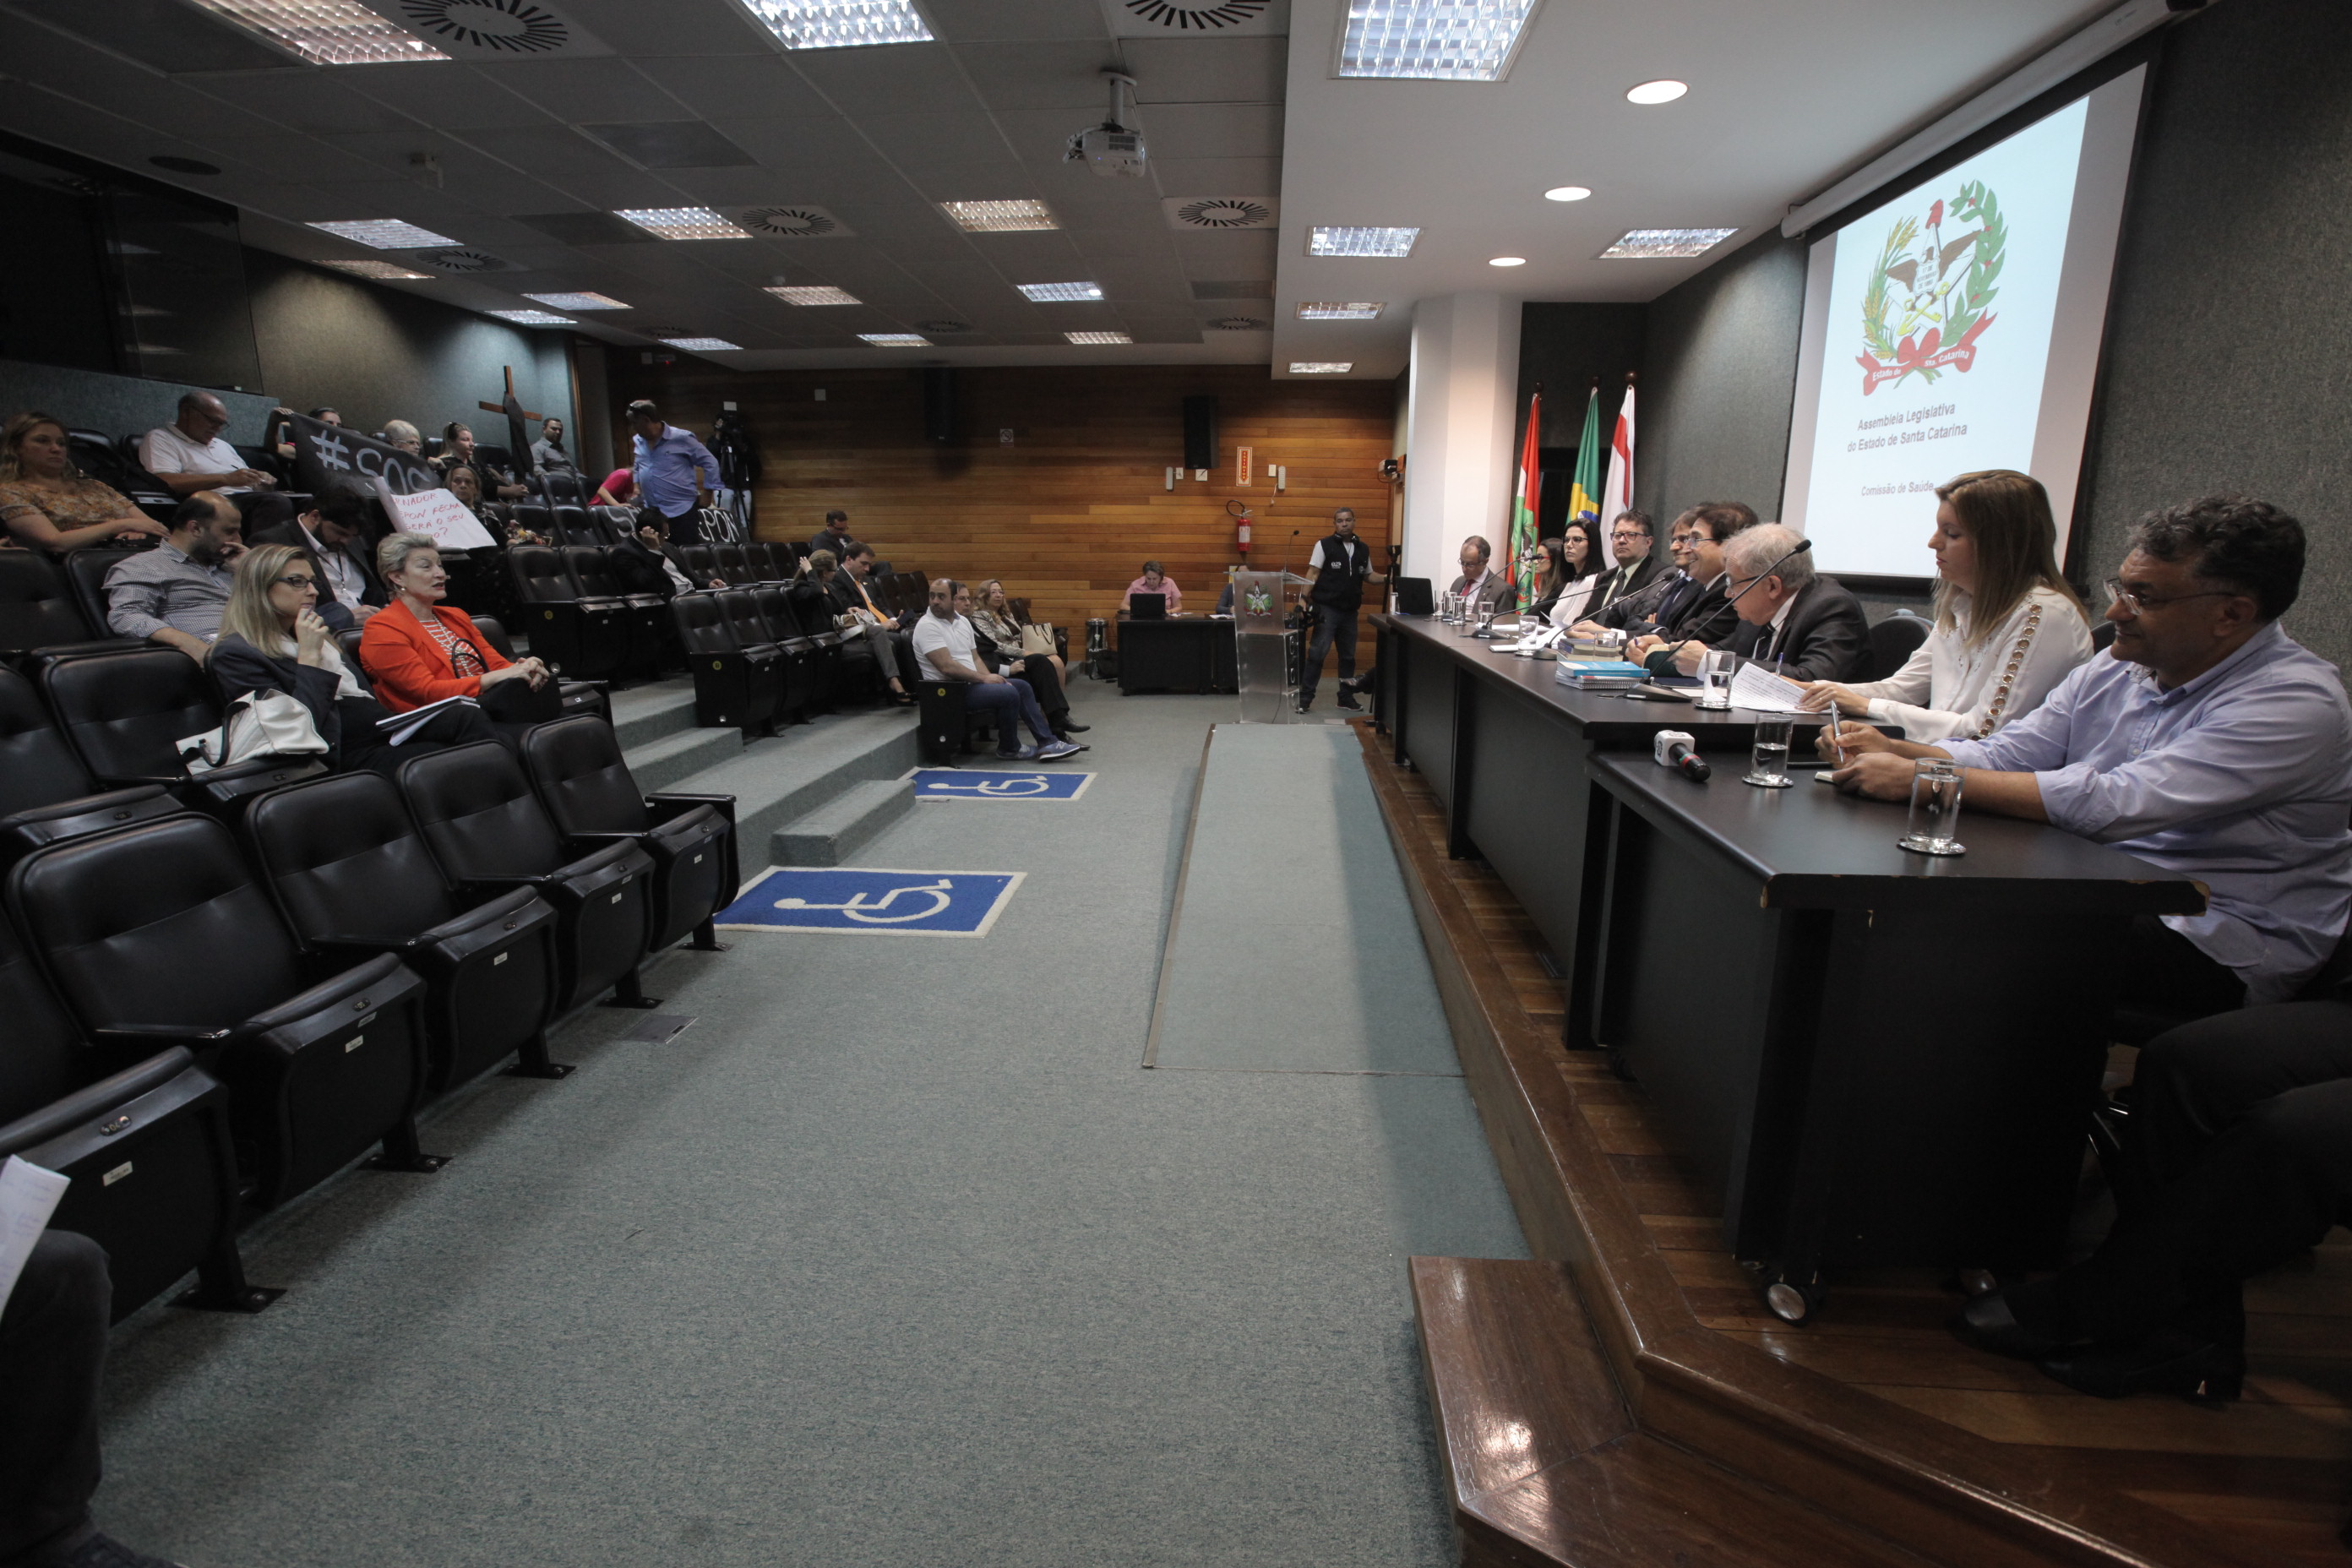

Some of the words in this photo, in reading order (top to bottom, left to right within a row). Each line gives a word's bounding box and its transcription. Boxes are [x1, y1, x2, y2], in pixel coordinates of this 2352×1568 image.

[1872, 368, 1892, 381] Estado
[1939, 349, 1969, 362] Catarina
[1857, 412, 1903, 431] Assembleia
[1906, 403, 1956, 423] Legislativa
[1847, 442, 1856, 452] do
[1858, 436, 1886, 451] Estado
[1887, 434, 1898, 446] de
[1900, 429, 1925, 444] Santa
[1927, 423, 1968, 440] Catarina
[1861, 482, 1896, 496] Comissão
[1897, 483, 1906, 494] de
[1908, 480, 1934, 493] Saúde
[433, 503, 460, 515] FECHA
